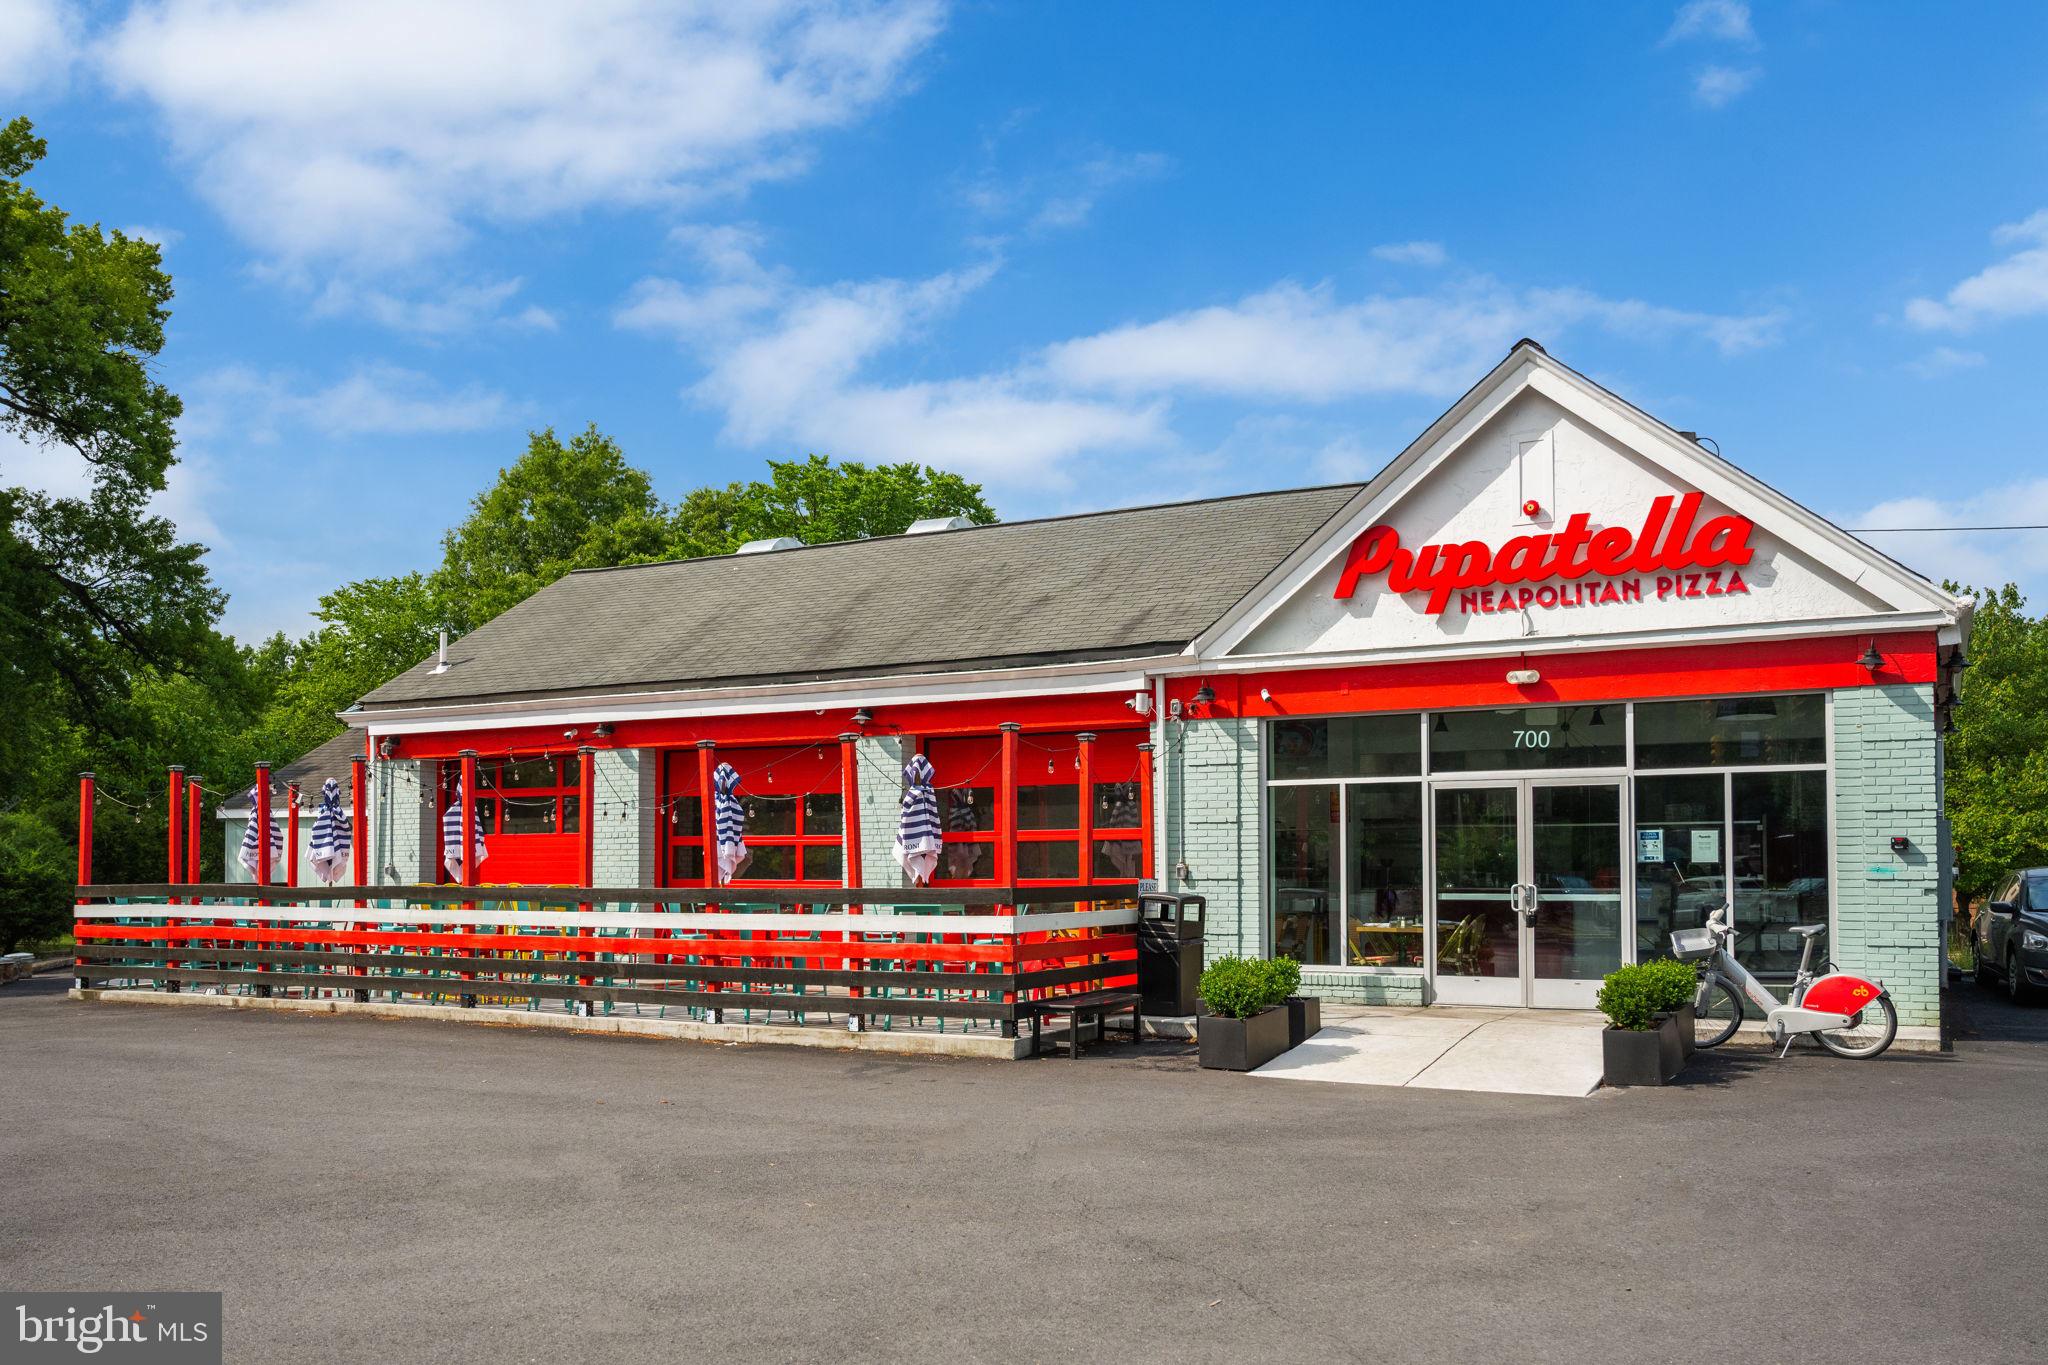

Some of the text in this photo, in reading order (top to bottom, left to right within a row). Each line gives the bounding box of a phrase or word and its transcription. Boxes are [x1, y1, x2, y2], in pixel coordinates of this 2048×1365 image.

[1333, 491, 1755, 615] Pupatella
[1460, 570, 1749, 615] NEAPOLITAN PIZZA
[1513, 730, 1550, 748] 700
